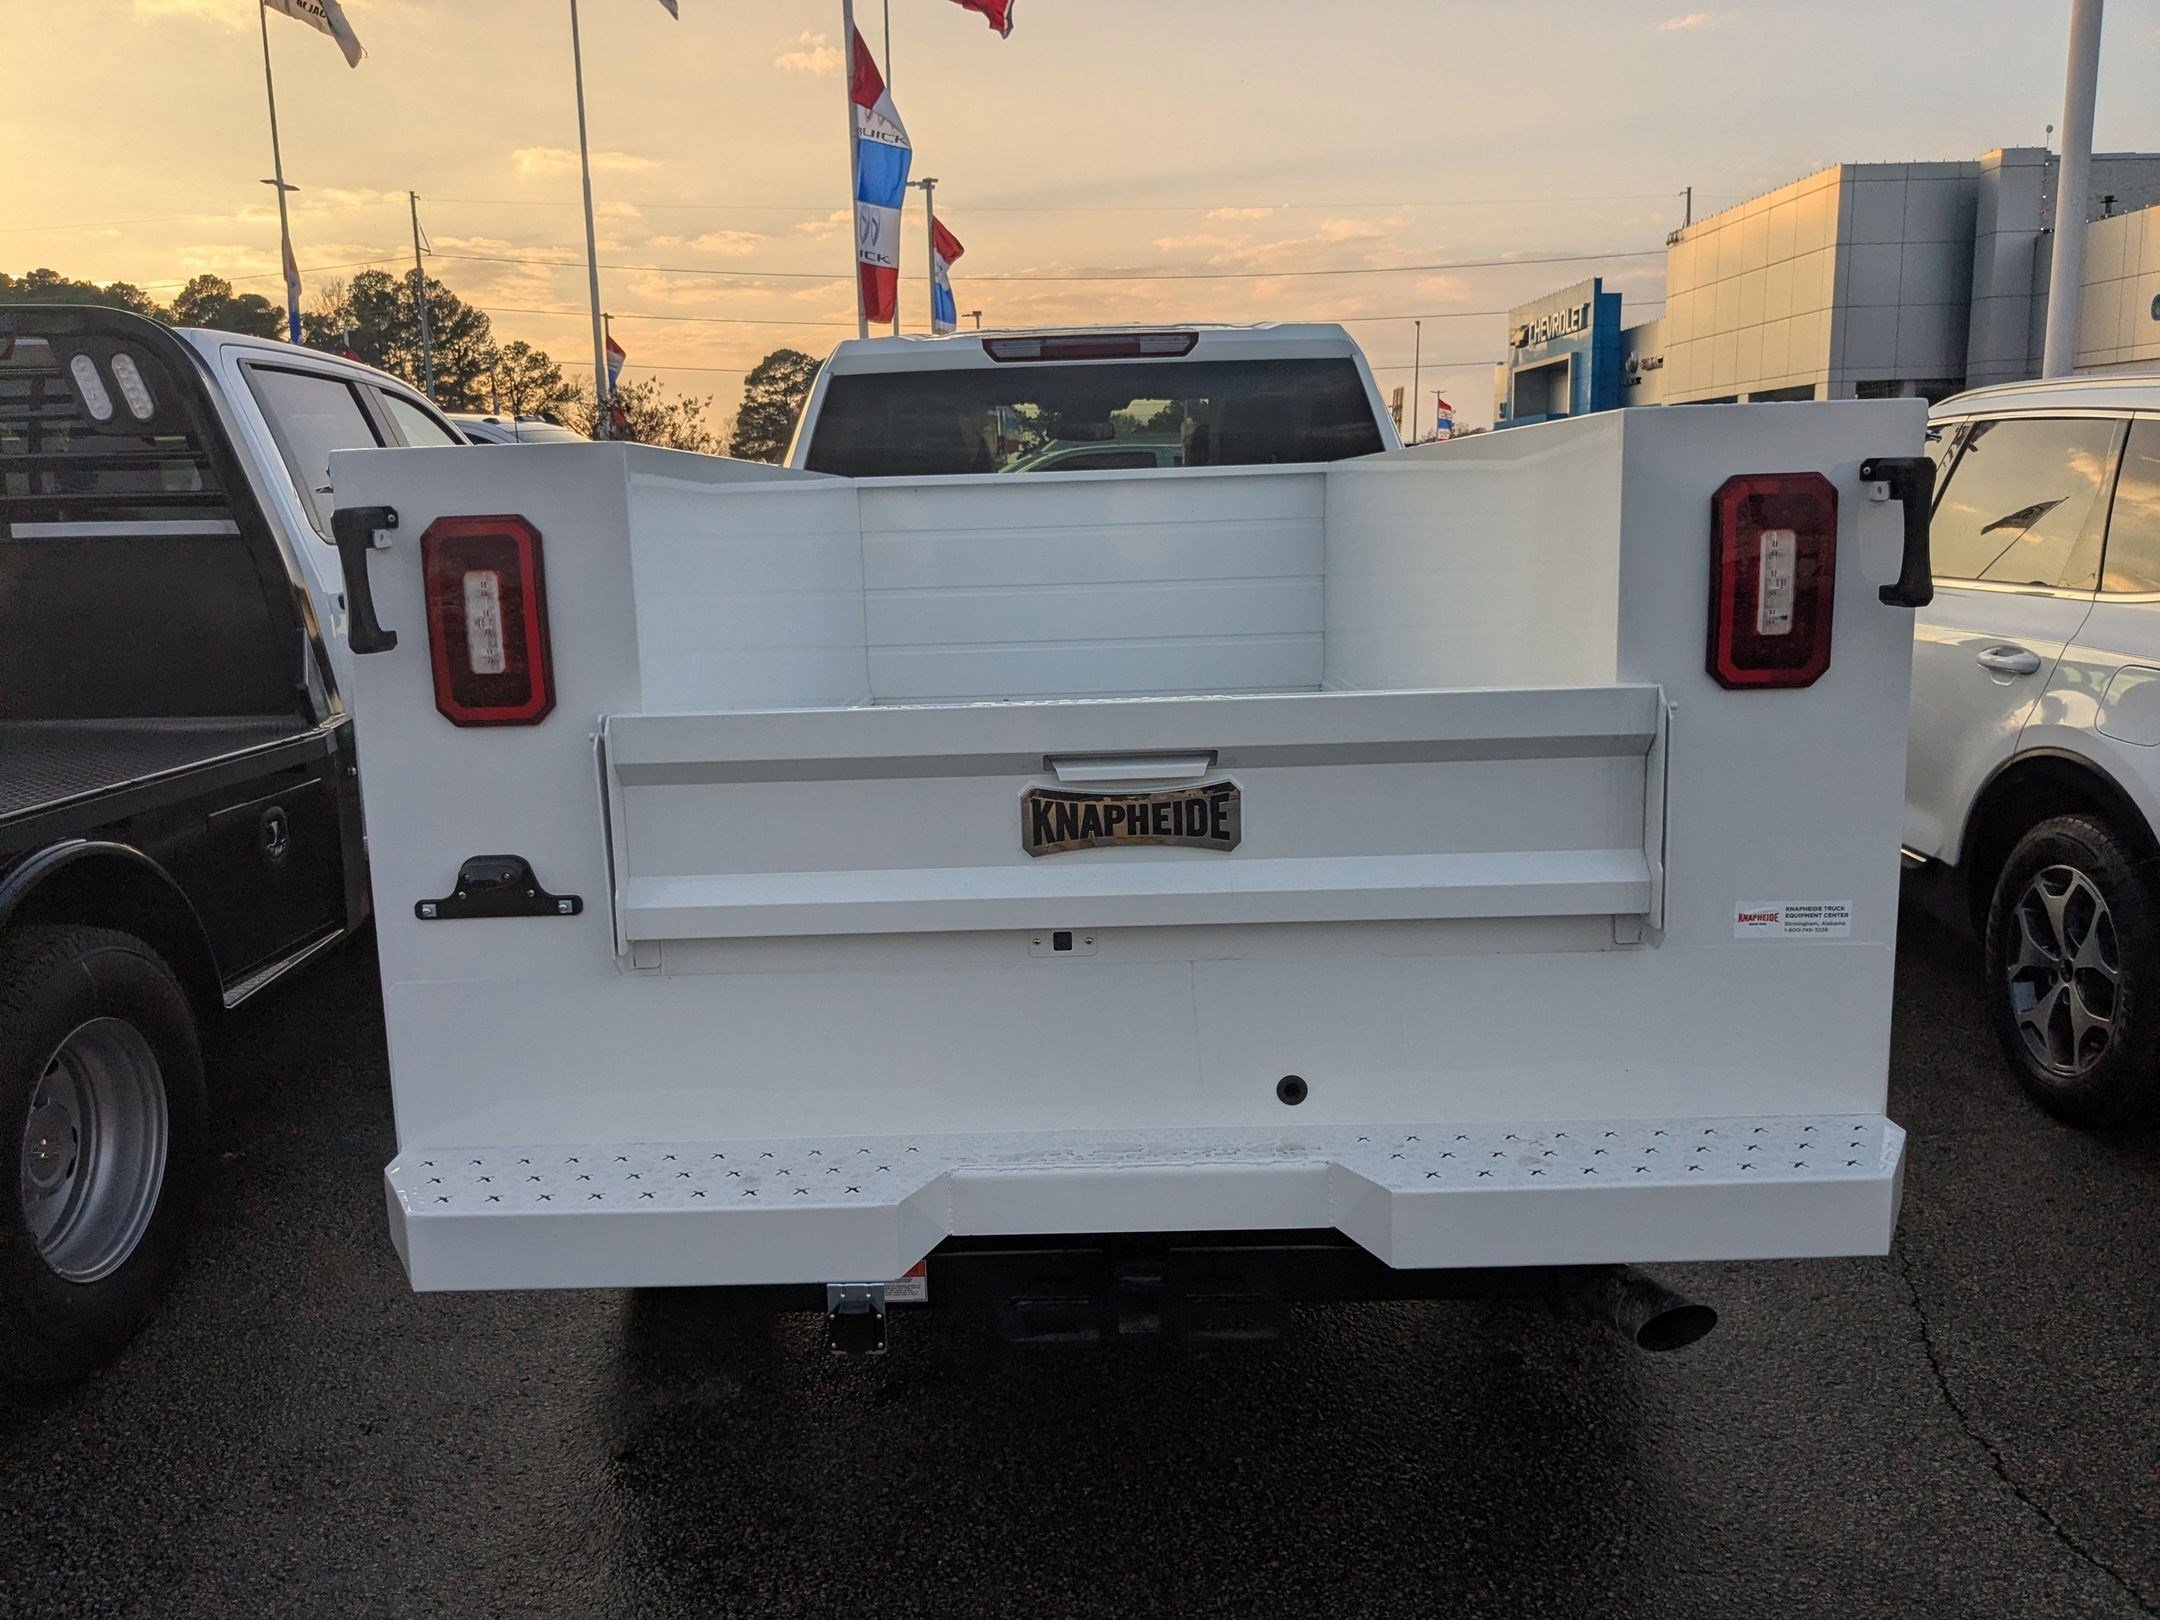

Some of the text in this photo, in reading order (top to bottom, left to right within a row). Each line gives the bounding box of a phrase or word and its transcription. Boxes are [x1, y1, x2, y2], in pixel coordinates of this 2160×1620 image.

[857, 127, 909, 146] BUICK
[860, 249, 892, 264] ICK
[1527, 304, 1588, 346] CHEVROLET
[1031, 793, 1231, 847] KNAPHEIDE
[1737, 912, 1780, 923] KNAPHEIDE
